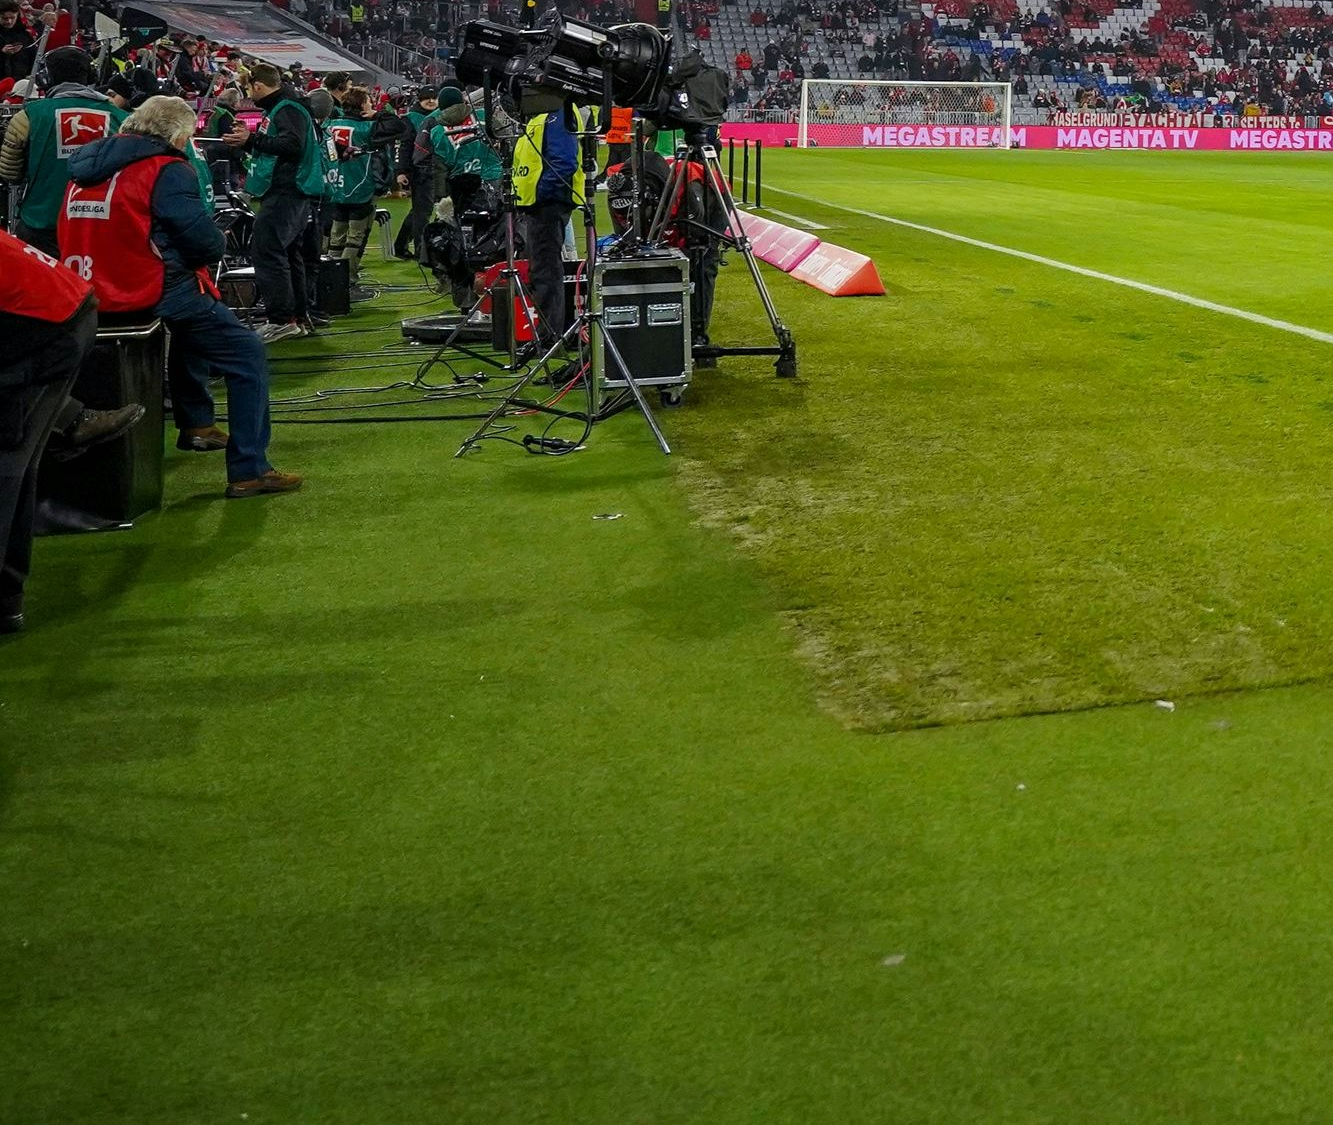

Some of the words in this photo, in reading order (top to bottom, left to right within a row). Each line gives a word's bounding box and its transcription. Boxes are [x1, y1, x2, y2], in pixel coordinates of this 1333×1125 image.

[862, 126, 1027, 147] MEGASTREAM
[1056, 128, 1169, 148] MAGENTA
[1168, 129, 1199, 149] TV
[70, 204, 105, 214] NDESLIGA
